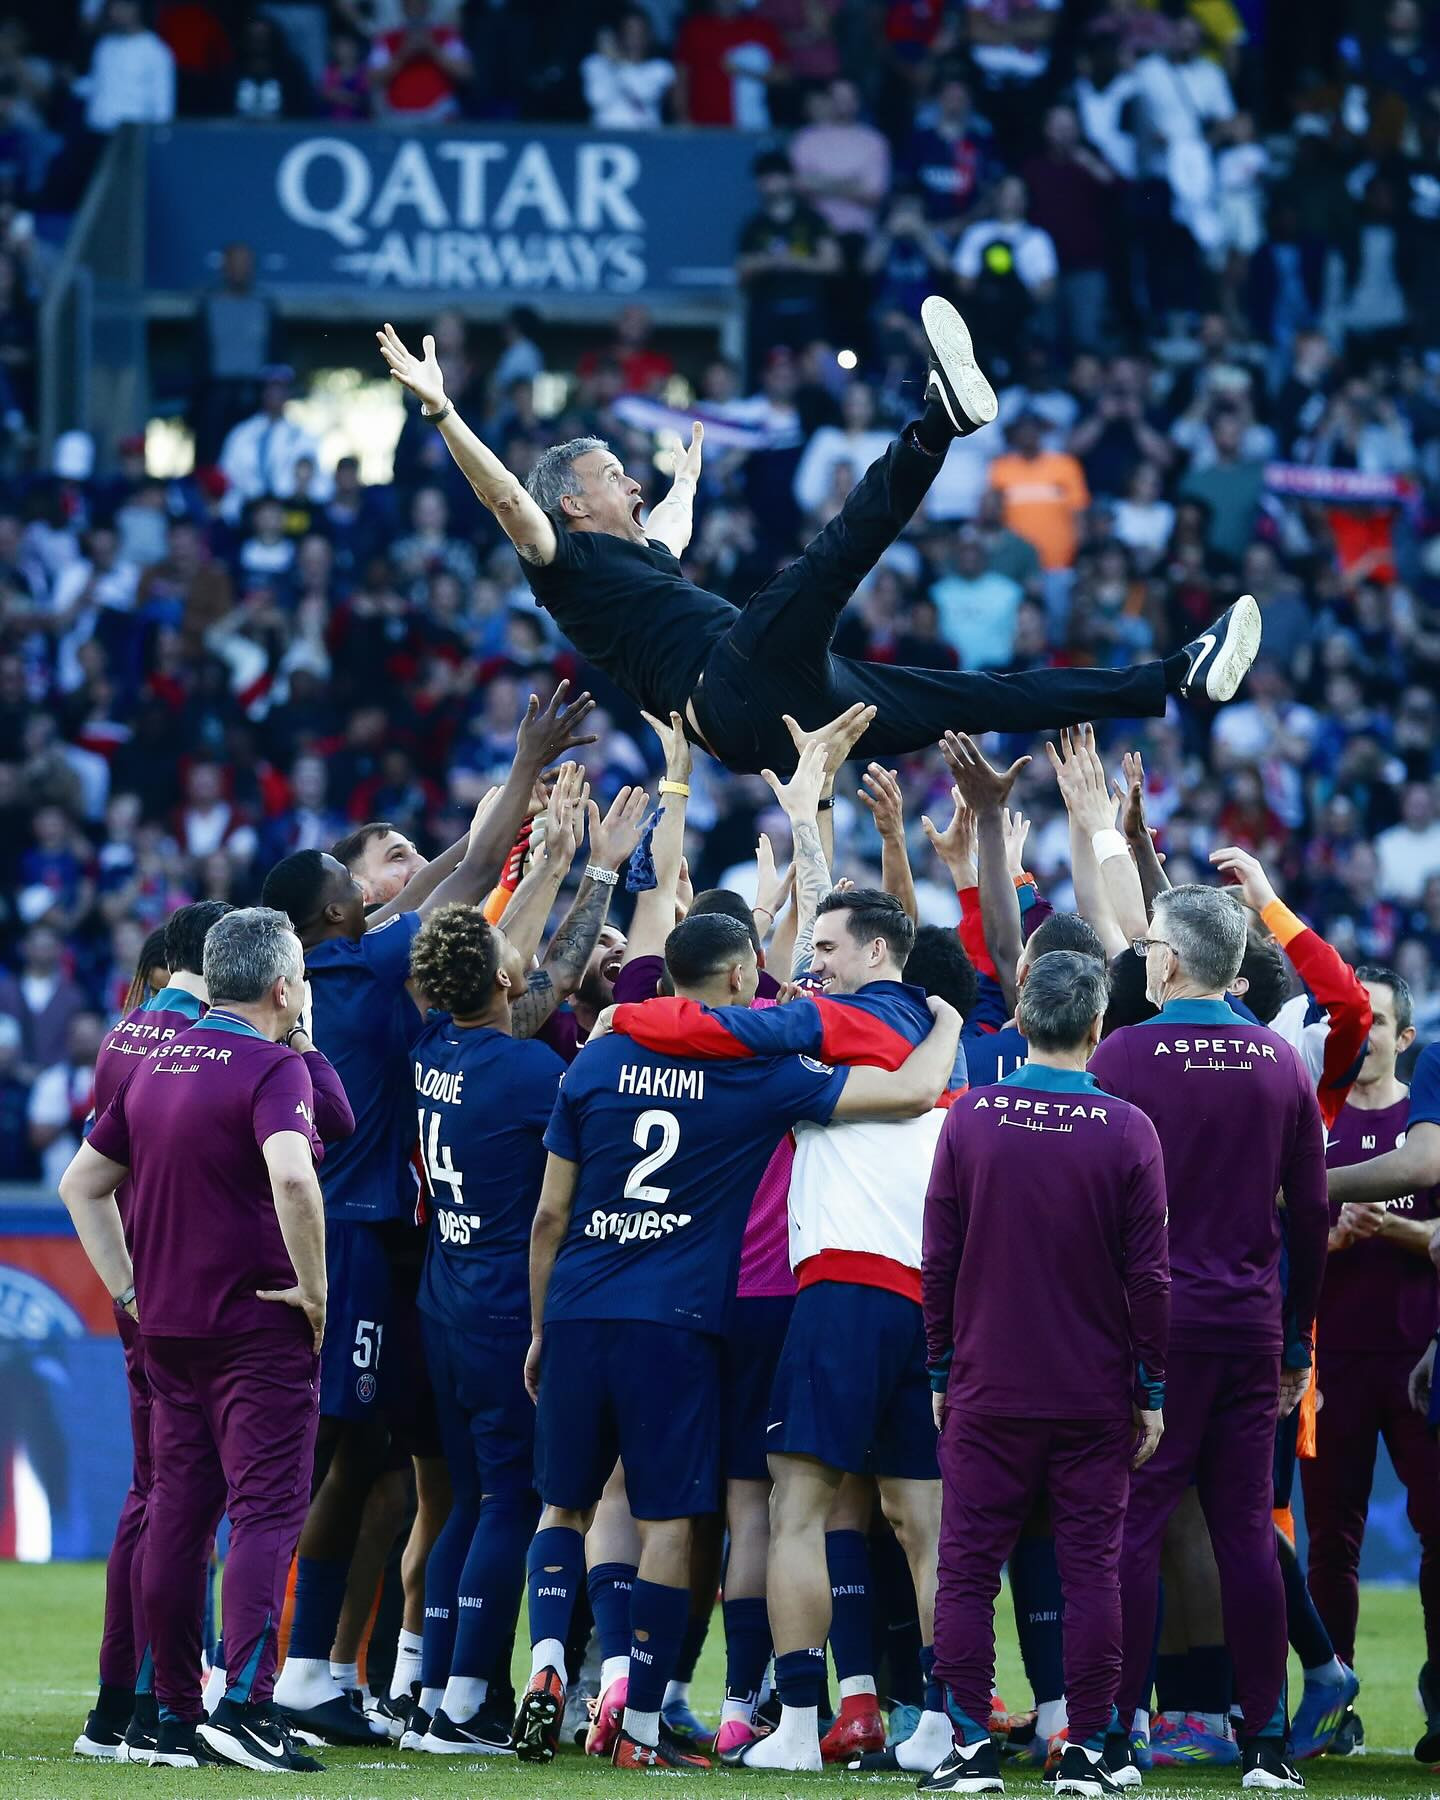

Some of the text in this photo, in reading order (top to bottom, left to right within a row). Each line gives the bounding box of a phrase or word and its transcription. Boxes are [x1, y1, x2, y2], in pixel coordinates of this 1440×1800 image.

[276, 136, 645, 247] QATAR
[365, 230, 647, 293] AIRWAYS
[114, 1020, 176, 1041] SPETAR
[148, 1045, 232, 1065] ASPETAR
[1154, 1039, 1278, 1063] ASPETAR
[415, 1061, 464, 1104] D.DOUÉ
[618, 1064, 704, 1100] HAKIMI
[973, 1096, 1108, 1125] ASPETAR
[1361, 1135, 1376, 1150] MJ
[417, 1108, 464, 1204] 14
[624, 1110, 680, 1204] 2
[353, 1319, 384, 1370] 51
[458, 1596, 483, 1609] PARIS
[538, 1587, 567, 1598] PARIS
[832, 1585, 865, 1598] PARIS
[425, 1607, 449, 1619] PARIS
[631, 1646, 654, 1665] PARIS
